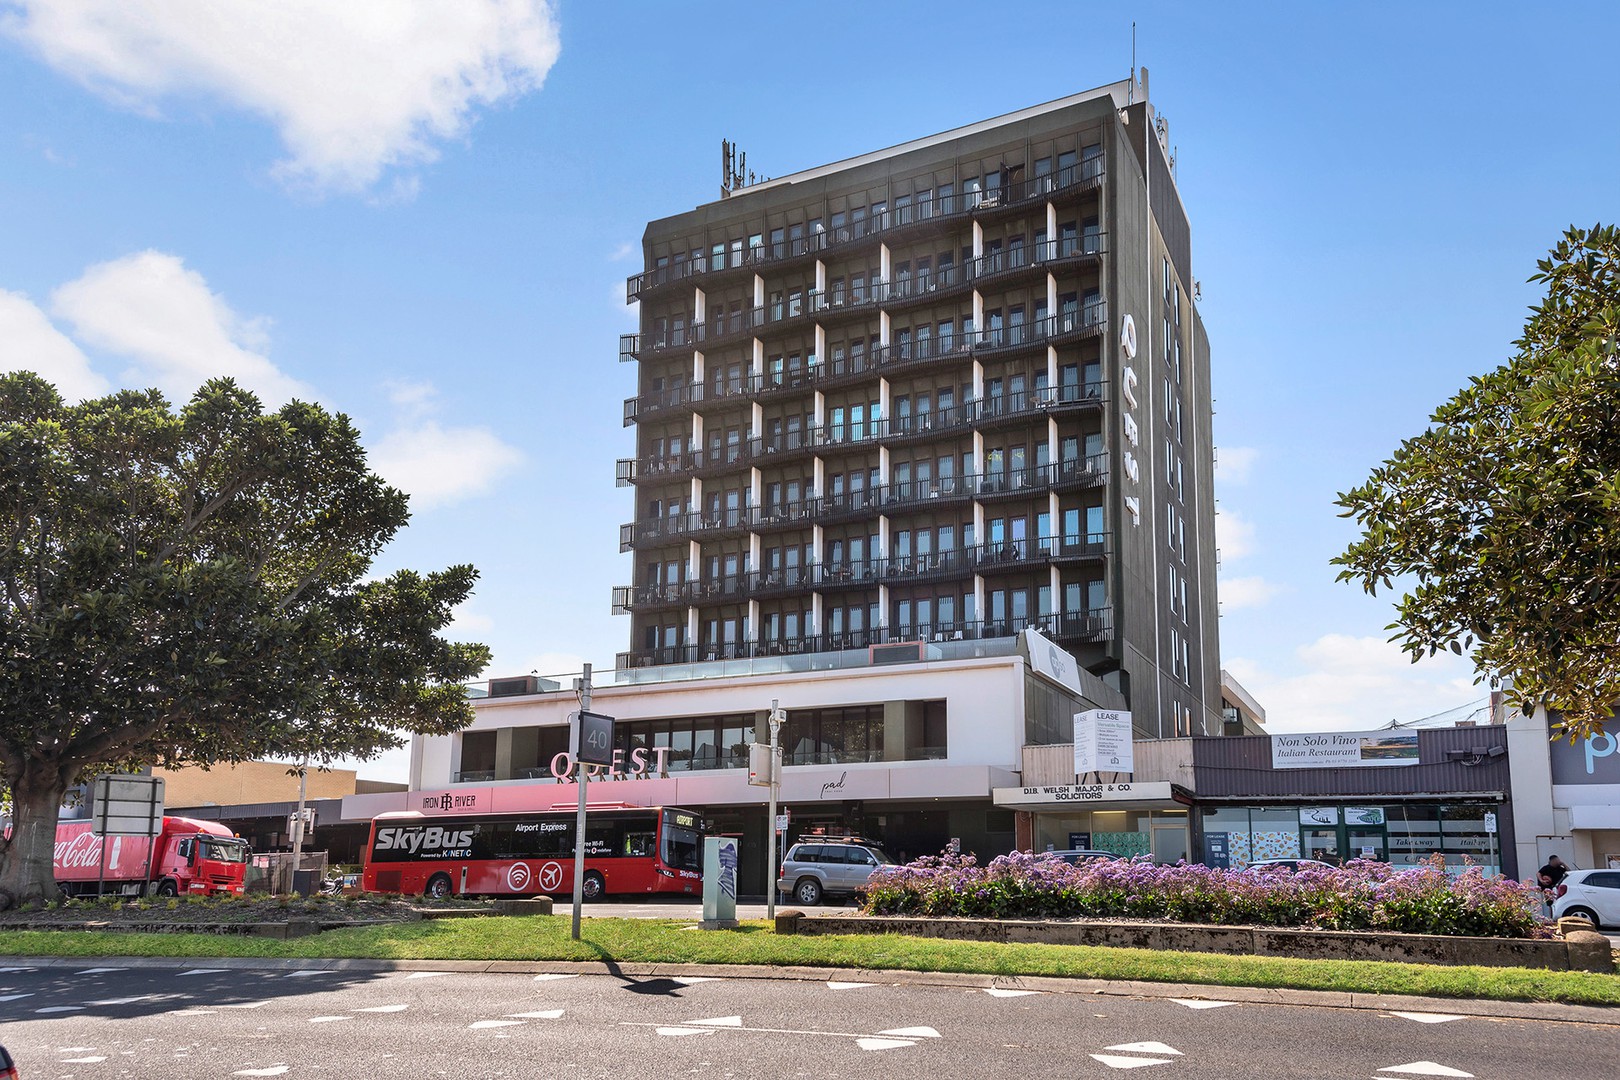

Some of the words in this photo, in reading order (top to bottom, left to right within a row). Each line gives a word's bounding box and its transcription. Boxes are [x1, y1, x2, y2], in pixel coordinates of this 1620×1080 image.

[1121, 313, 1140, 528] QUEST
[1096, 712, 1120, 721] LEASE
[587, 729, 607, 749] 40
[1277, 737, 1300, 747] Non
[1302, 735, 1328, 746] Solo
[1332, 735, 1357, 745] Vino
[1277, 749, 1306, 757] Italian
[1308, 748, 1357, 757] Restaurant
[550, 746, 672, 784] QEST
[820, 770, 847, 799] pad
[1043, 786, 1070, 794] WELSH
[1075, 785, 1104, 793] MAJOR
[1055, 791, 1103, 800] SOLICITORS
[422, 797, 439, 809] IRON
[454, 795, 476, 807] RIVER
[515, 823, 539, 833] Airport
[540, 823, 567, 832] Express
[375, 826, 474, 854] SkyBus
[680, 870, 699, 878] SkyBus
